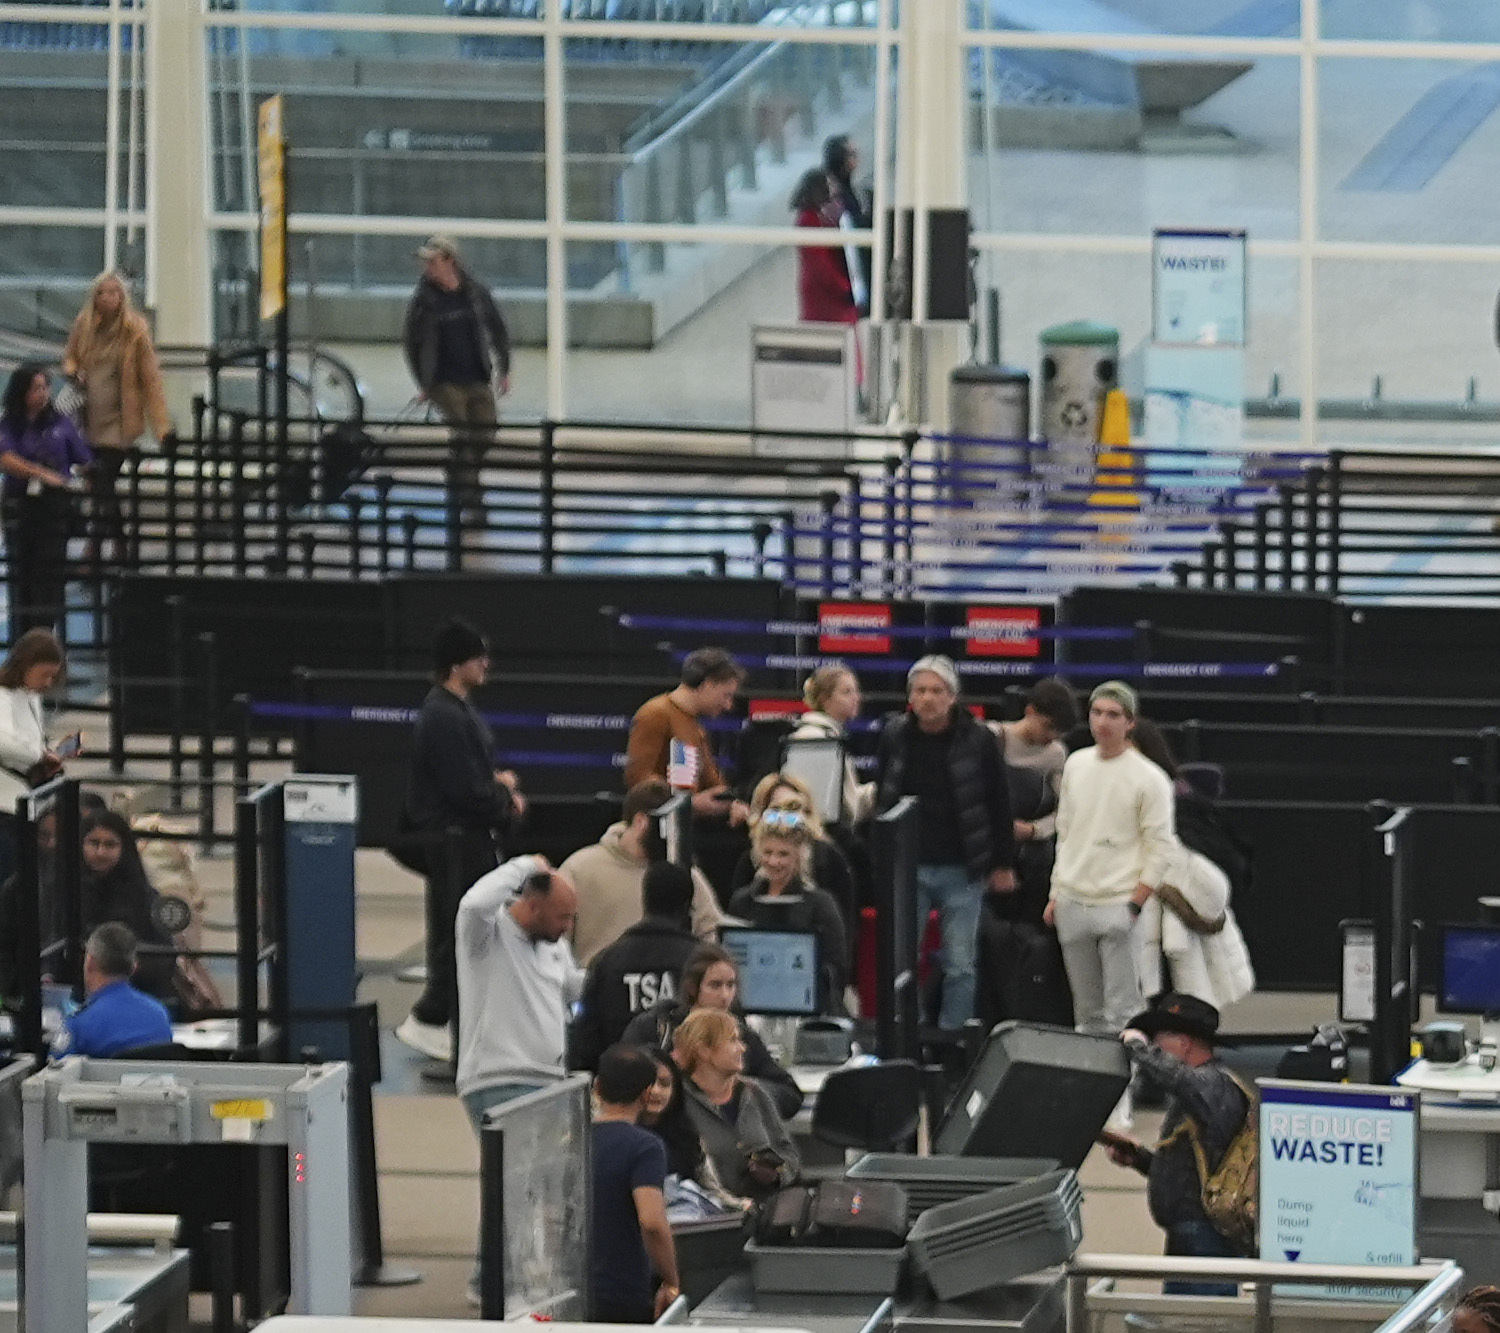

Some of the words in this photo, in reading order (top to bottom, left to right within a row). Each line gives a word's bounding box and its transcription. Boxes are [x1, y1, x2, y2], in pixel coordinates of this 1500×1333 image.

[622, 970, 675, 1013] TSA
[1269, 1113, 1393, 1143] REDUCE
[1271, 1138, 1384, 1167] WASTE!
[1277, 1198, 1313, 1212] Dump
[1277, 1216, 1310, 1228] liquid
[1277, 1233, 1303, 1245] here
[1377, 1252, 1403, 1265] refill
